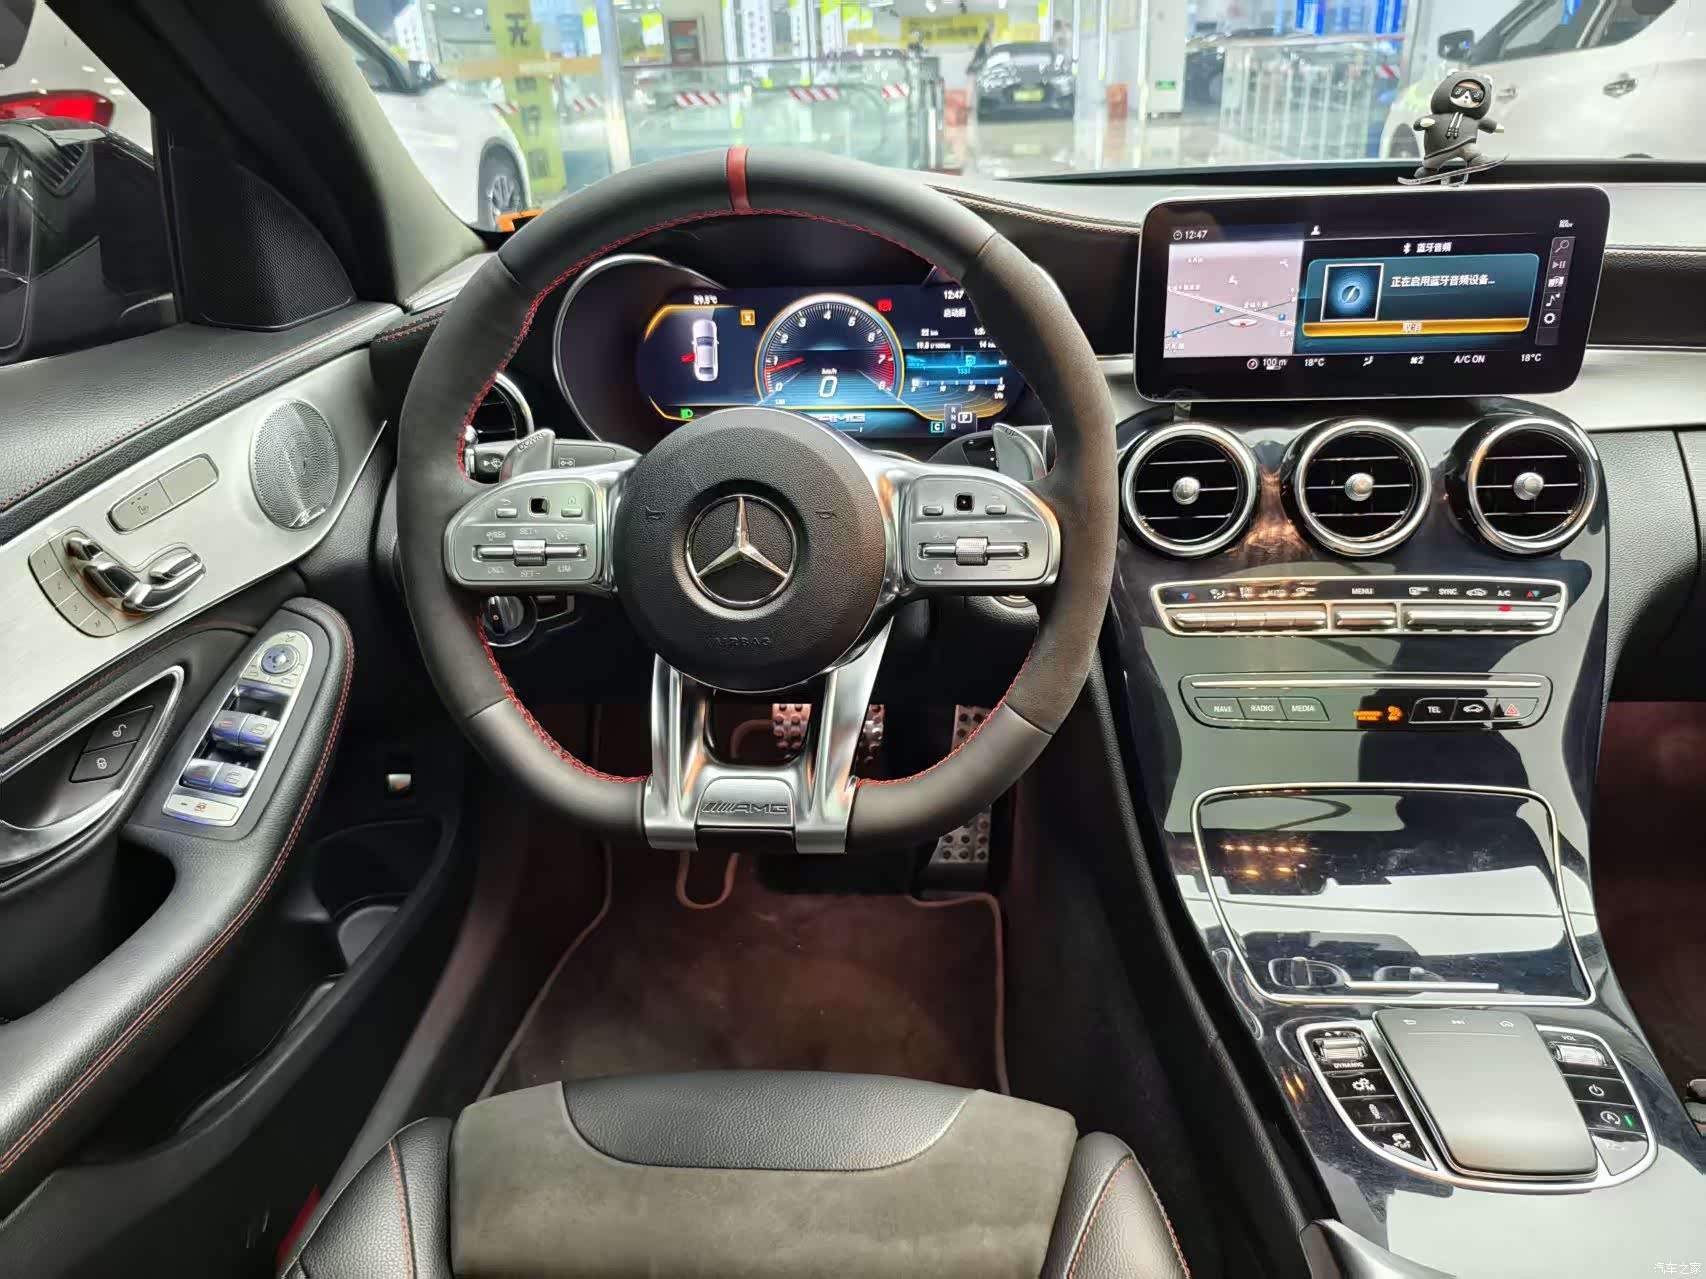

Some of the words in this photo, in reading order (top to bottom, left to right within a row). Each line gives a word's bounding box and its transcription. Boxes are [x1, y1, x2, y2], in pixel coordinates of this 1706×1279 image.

[1184, 230, 1208, 240] 12:47
[1416, 241, 1452, 253] 蓝牙音频
[823, 310, 832, 320] 4
[798, 317, 807, 328] 3
[780, 333, 789, 344] 2
[878, 354, 886, 365] 7
[1262, 358, 1277, 367] 100
[1304, 358, 1325, 367] 18°C
[1454, 355, 1471, 364] A/C
[1472, 355, 1485, 364] ON
[1521, 353, 1542, 363] 18°C
[819, 375, 838, 398] 0
[1438, 588, 1458, 596] SYNC
[1497, 590, 1511, 598] A/C
[1250, 705, 1274, 713] RADIO
[1291, 705, 1315, 713] MEDIA
[1427, 705, 1441, 714] TEL
